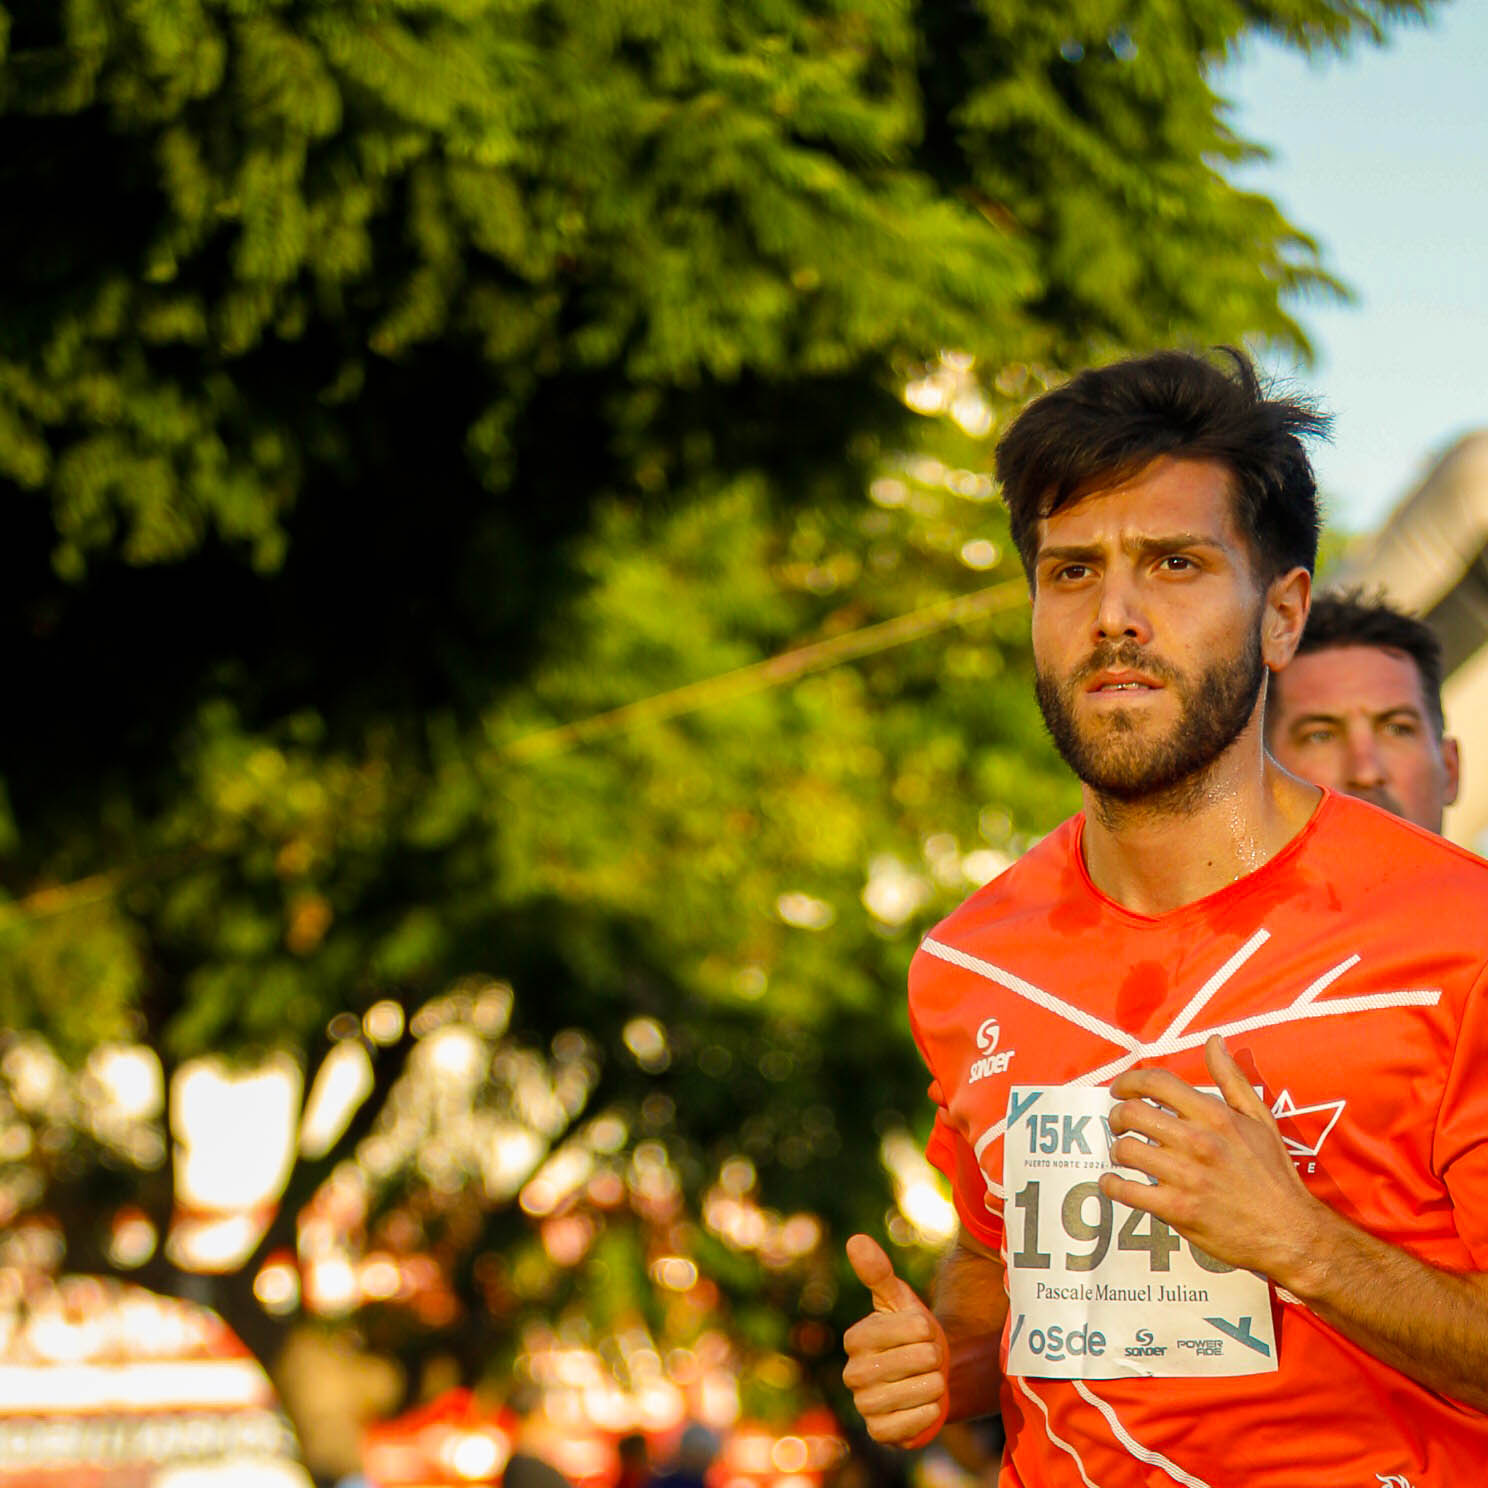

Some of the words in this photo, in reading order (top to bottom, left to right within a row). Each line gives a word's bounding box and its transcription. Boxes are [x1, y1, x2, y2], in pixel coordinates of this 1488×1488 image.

[1026, 1114, 1092, 1154] 15K
[1024, 1159, 1050, 1168] PUERTO
[1053, 1160, 1080, 1169] NORTE
[1013, 1180, 1240, 1274] 194
[1036, 1282, 1093, 1301] Pascale
[1096, 1283, 1151, 1302] Manuel
[1158, 1285, 1208, 1302] Julian
[1176, 1339, 1224, 1349] POWER
